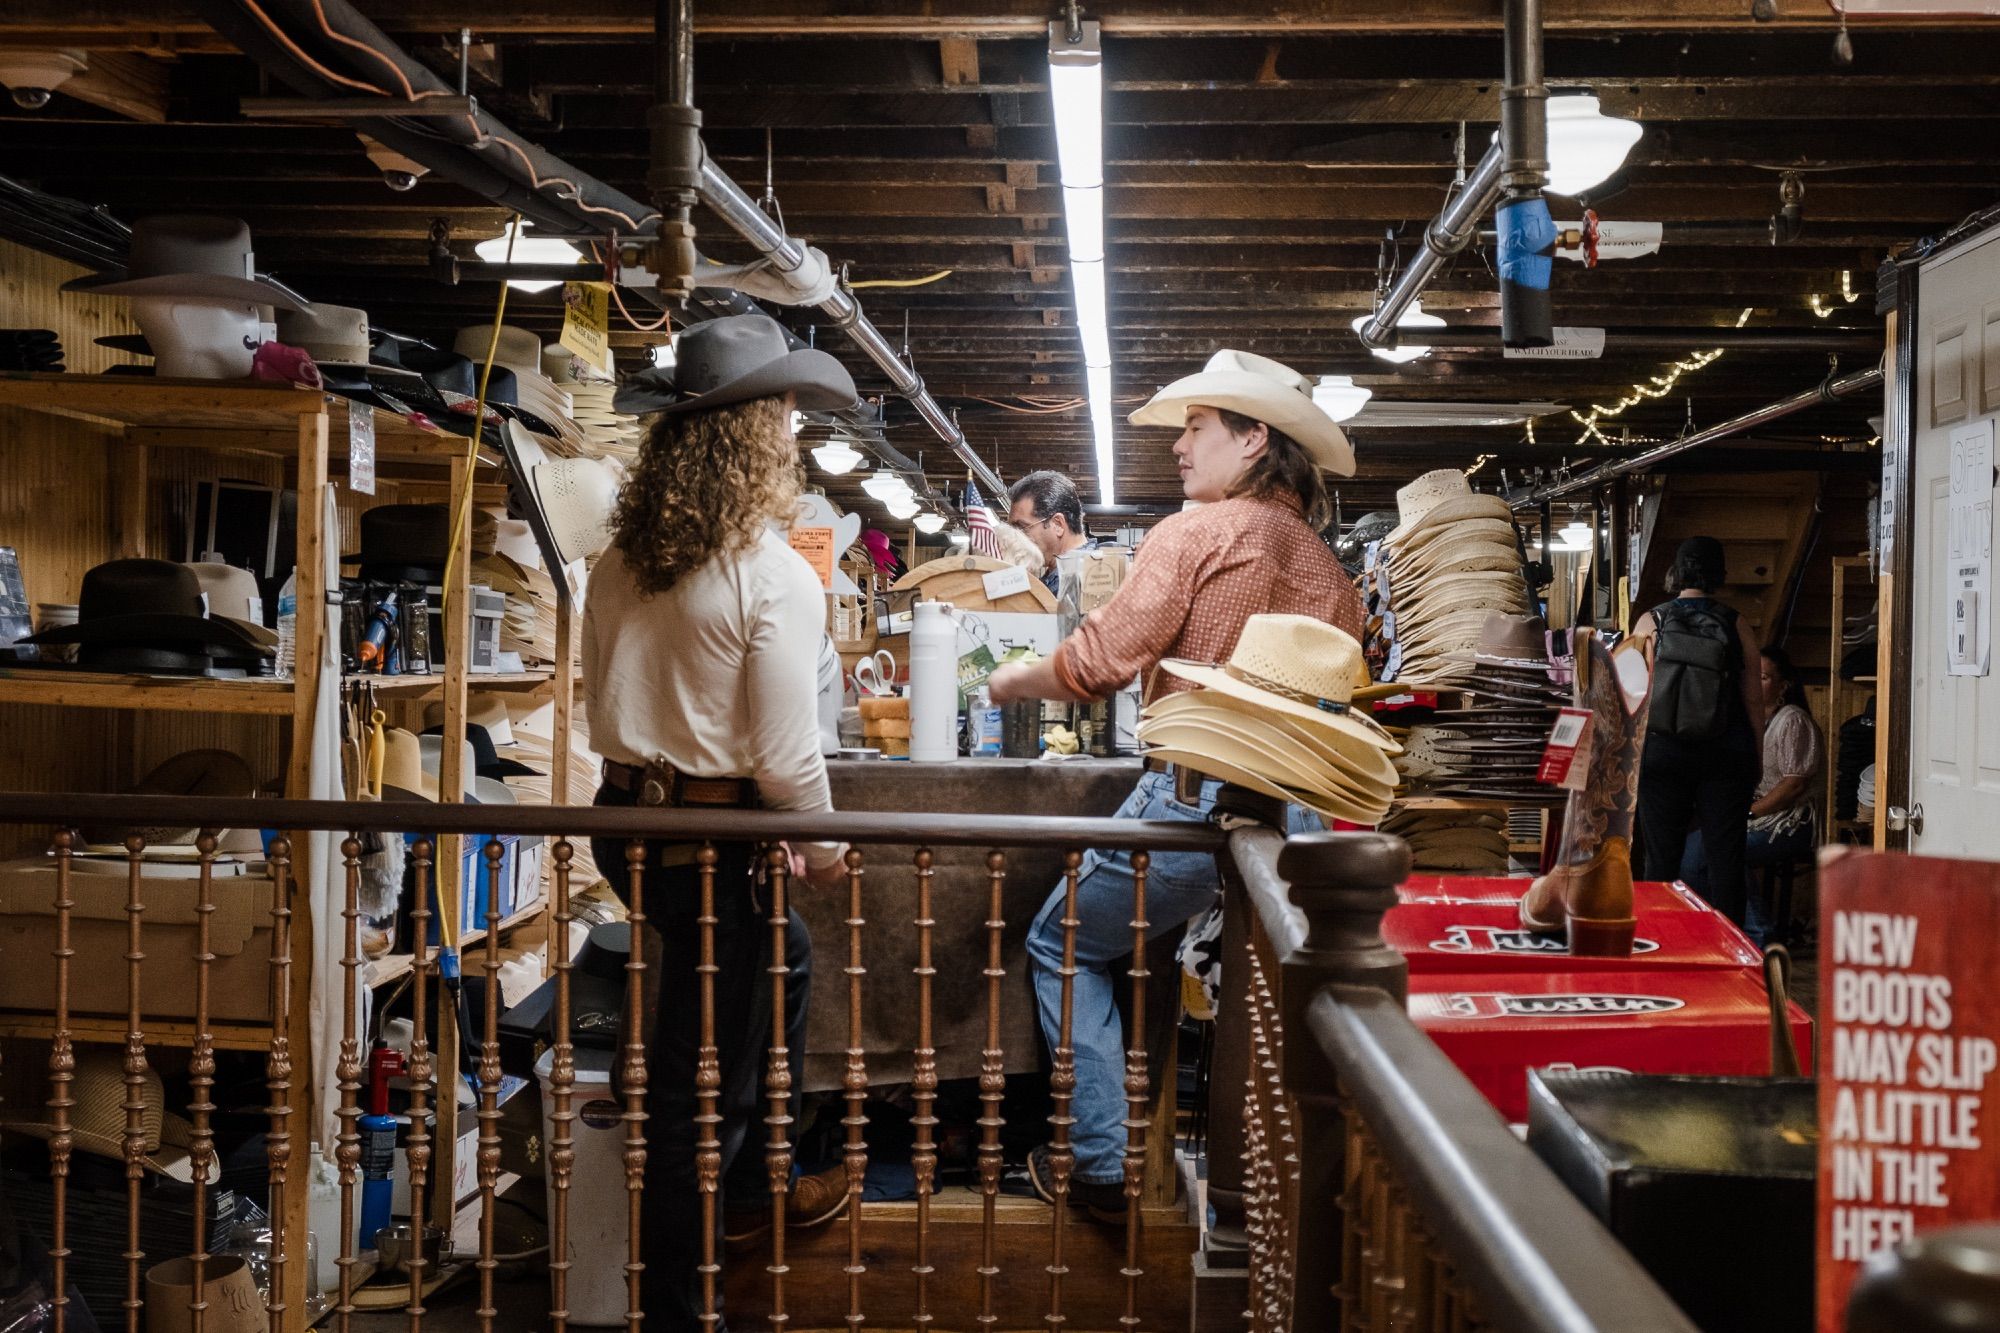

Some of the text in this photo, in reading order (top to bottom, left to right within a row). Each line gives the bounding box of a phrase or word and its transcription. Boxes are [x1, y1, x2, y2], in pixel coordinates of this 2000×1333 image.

[1952, 433, 1986, 494] OFF
[1833, 910, 1918, 968] NEW
[1431, 992, 1672, 1019] Justin
[1833, 968, 1952, 1030] BOOTS
[1833, 1027, 1998, 1090] MAY SLIP
[1832, 1087, 1982, 1150] A LITTLE
[1833, 1146, 1949, 1207] IN THE
